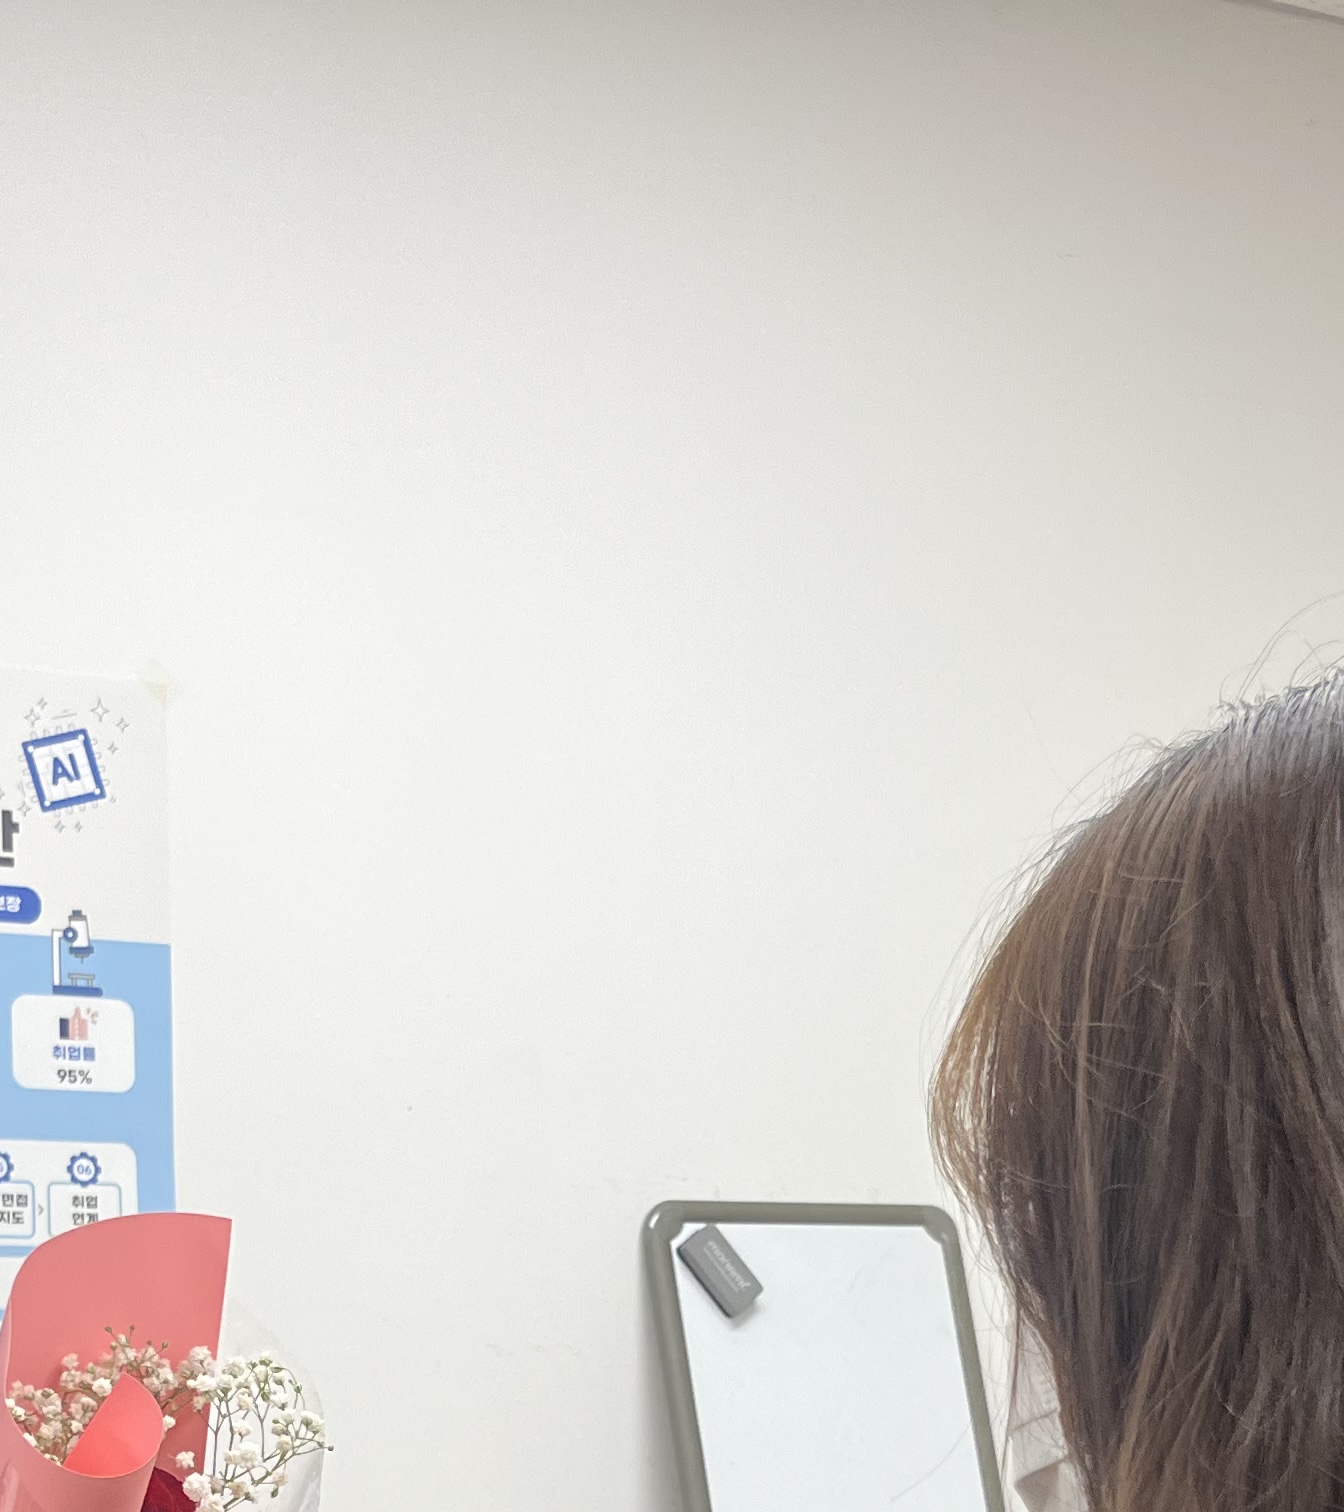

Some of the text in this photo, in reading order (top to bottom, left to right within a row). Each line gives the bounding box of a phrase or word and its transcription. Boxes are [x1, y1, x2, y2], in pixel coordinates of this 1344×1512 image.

[52, 753, 81, 786] AI
[56, 1069, 93, 1085] 95%
[76, 1163, 92, 1176] 06
[71, 1195, 98, 1209] 취업
